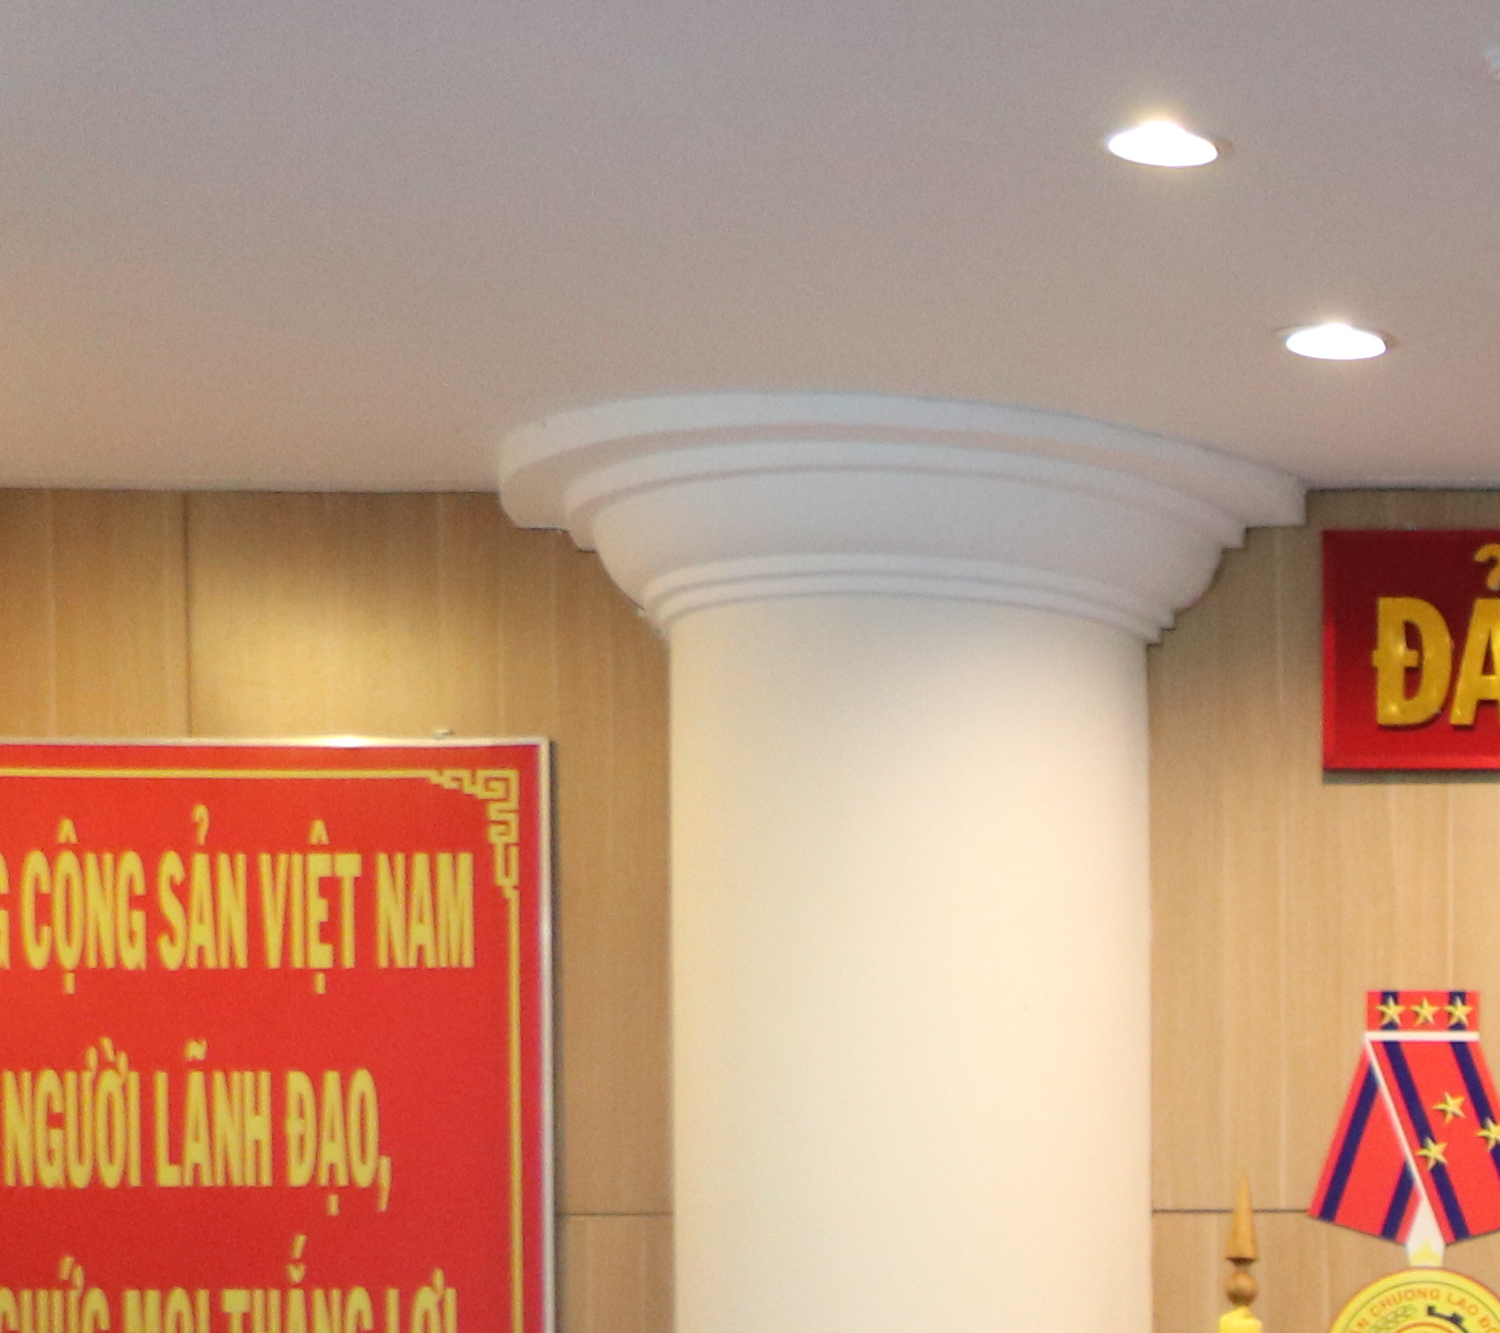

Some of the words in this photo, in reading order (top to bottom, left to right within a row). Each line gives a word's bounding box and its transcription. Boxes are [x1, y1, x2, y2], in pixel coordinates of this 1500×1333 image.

[22, 818, 146, 994] CỘNG
[158, 804, 247, 970] SẢN
[259, 820, 361, 994] VIỆT
[376, 852, 474, 969] NAM
[3, 1037, 142, 1190] NGƯỜI
[154, 1041, 272, 1188] LÃNH
[285, 1067, 390, 1215] ĐẠO,
